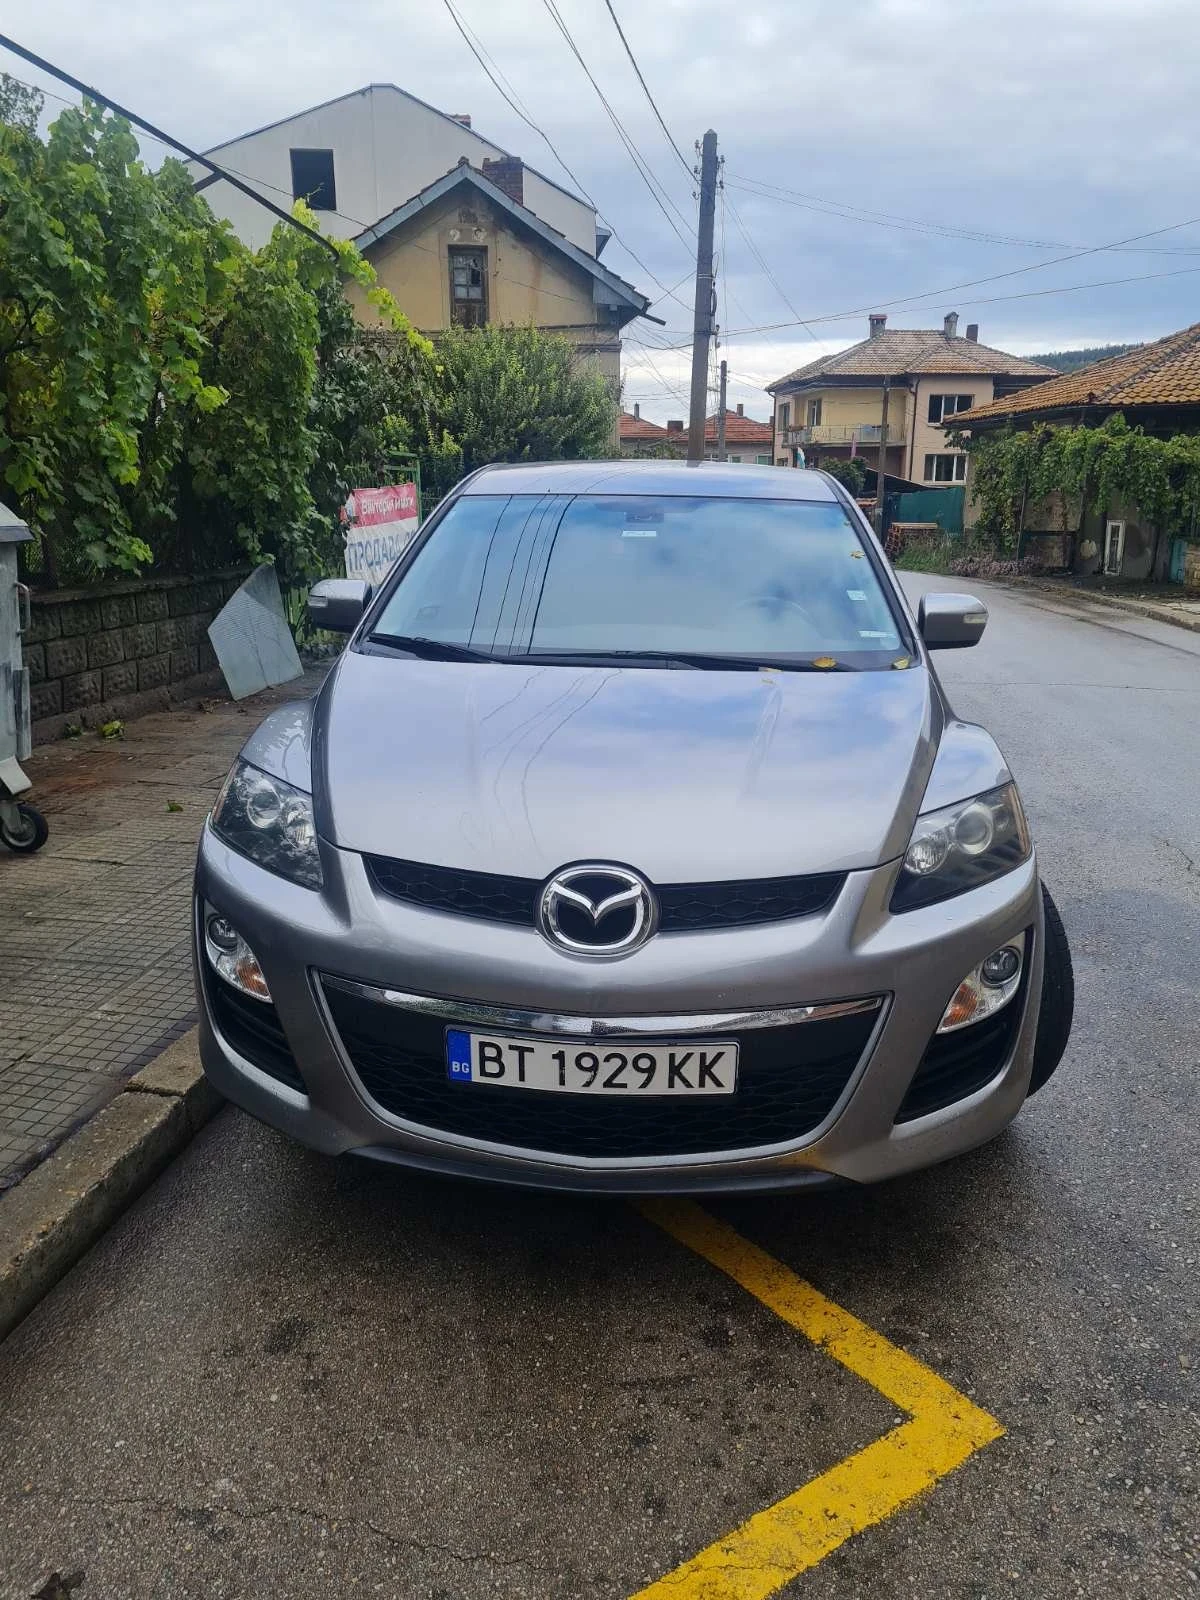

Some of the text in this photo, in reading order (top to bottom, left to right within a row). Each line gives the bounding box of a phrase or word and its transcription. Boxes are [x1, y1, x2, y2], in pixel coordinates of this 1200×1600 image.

[451, 1061, 470, 1074] BG
[478, 1040, 726, 1089] BT 1929 KK
